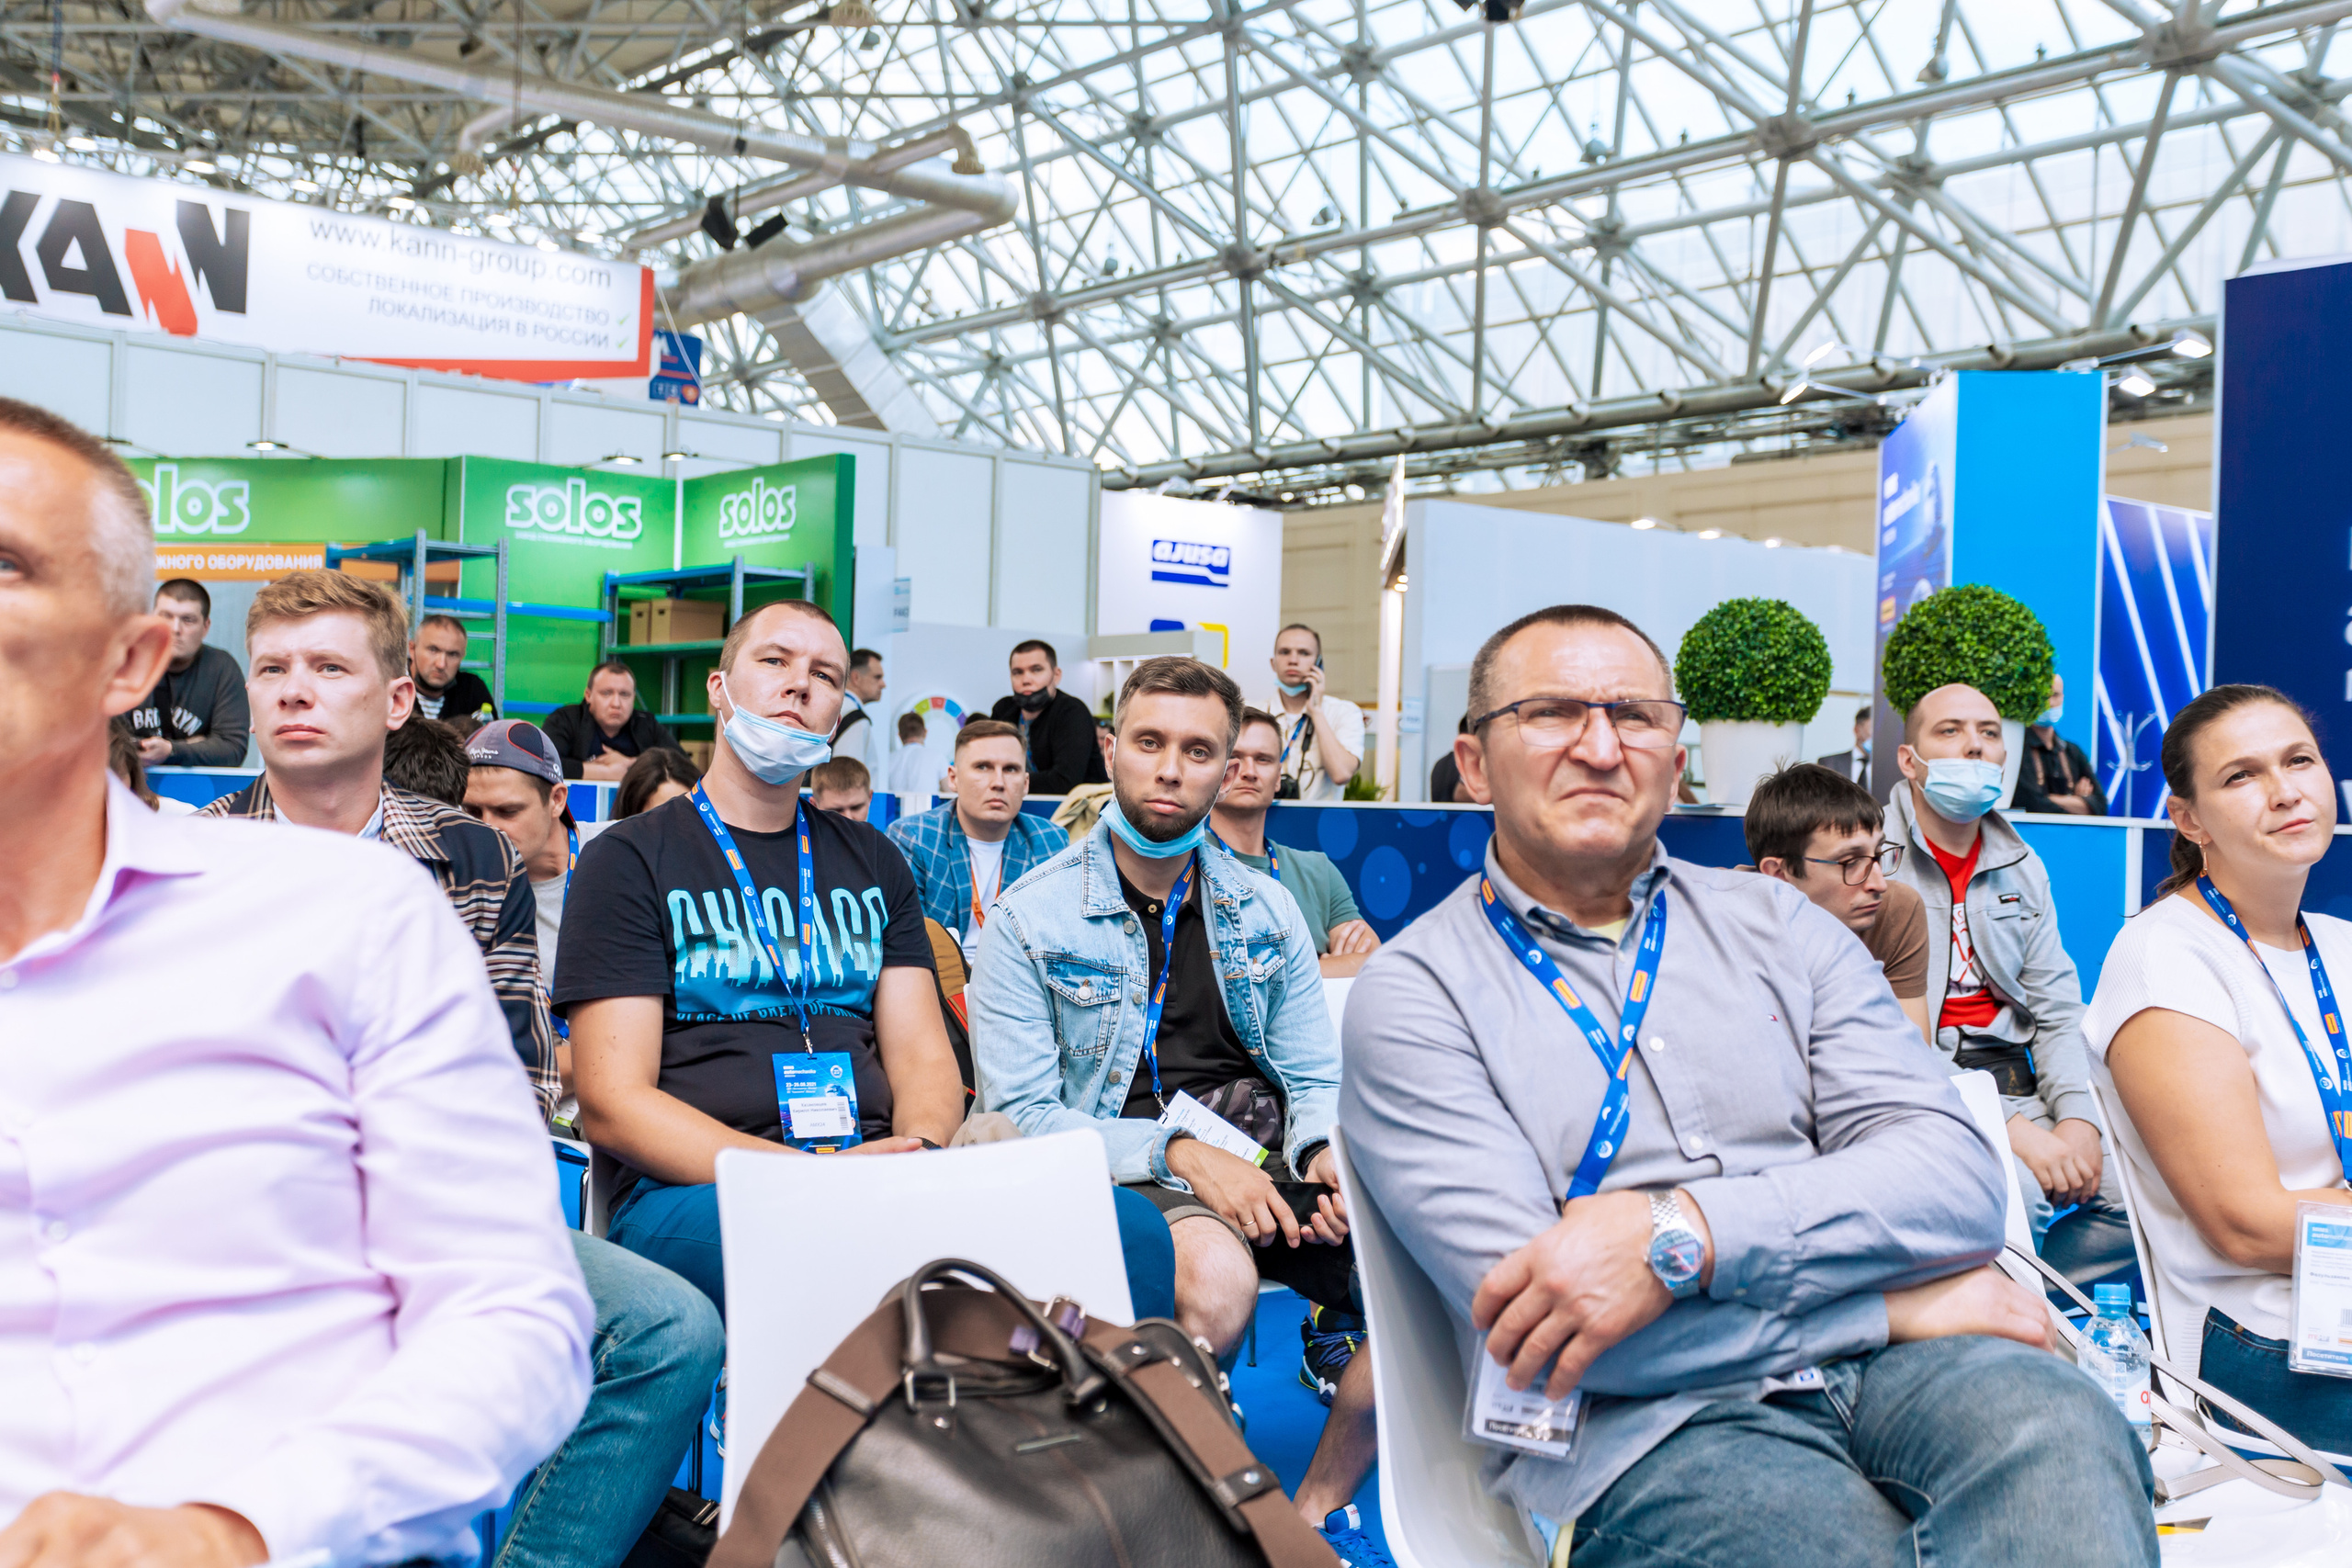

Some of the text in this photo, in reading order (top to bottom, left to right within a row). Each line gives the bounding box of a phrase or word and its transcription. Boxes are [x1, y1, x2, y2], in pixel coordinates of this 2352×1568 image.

[310, 219, 612, 288] www.kann-group.com
[306, 261, 610, 327] СОБСТВЕННОЕ ПРОИЗВОДСТВО
[367, 295, 610, 351] ЛОКАЛИЗАЦИЯ В РОССИИ
[505, 477, 643, 540] solos
[718, 477, 797, 538] solos
[208, 554, 322, 572] ОБОРУДОВАНИЯ
[757, 1006, 797, 1019] GREA
